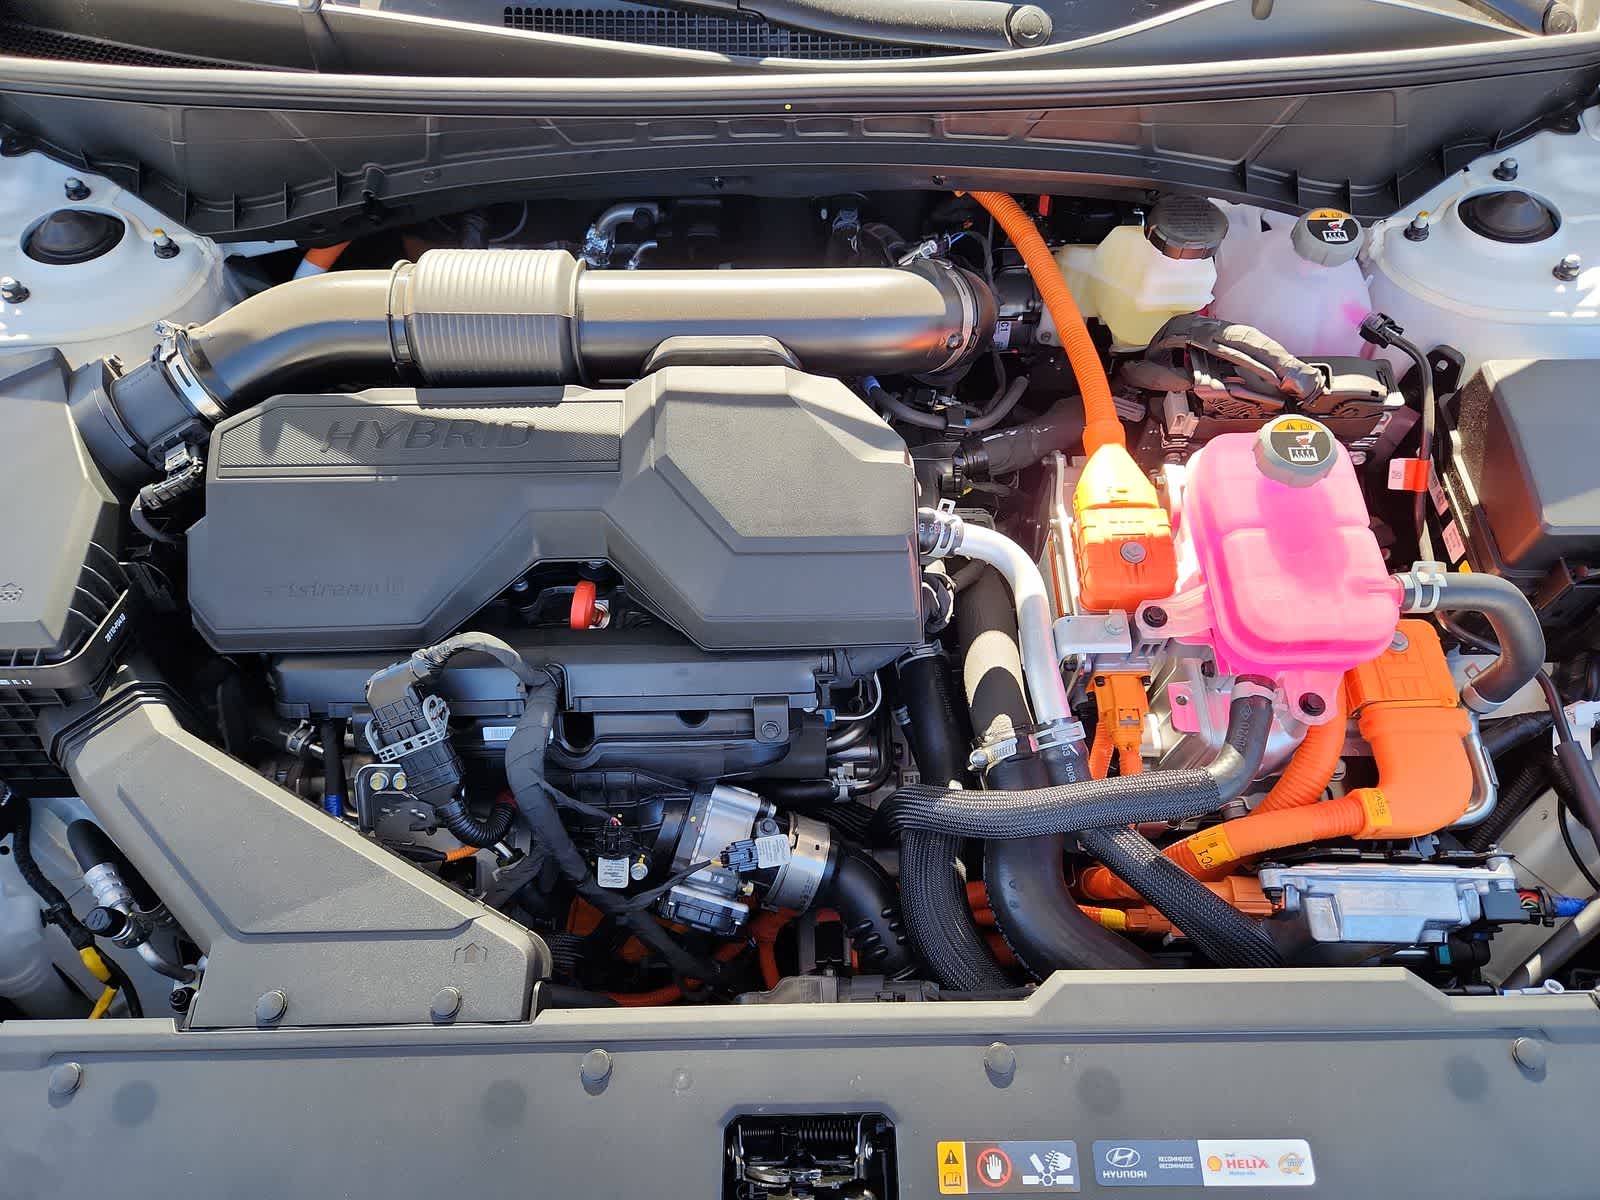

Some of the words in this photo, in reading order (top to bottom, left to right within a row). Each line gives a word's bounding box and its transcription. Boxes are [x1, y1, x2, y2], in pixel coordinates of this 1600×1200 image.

[319, 419, 535, 452] HYBRID
[1226, 1159, 1270, 1169] HELIX
[1103, 1170, 1148, 1179] HYUNDAI
